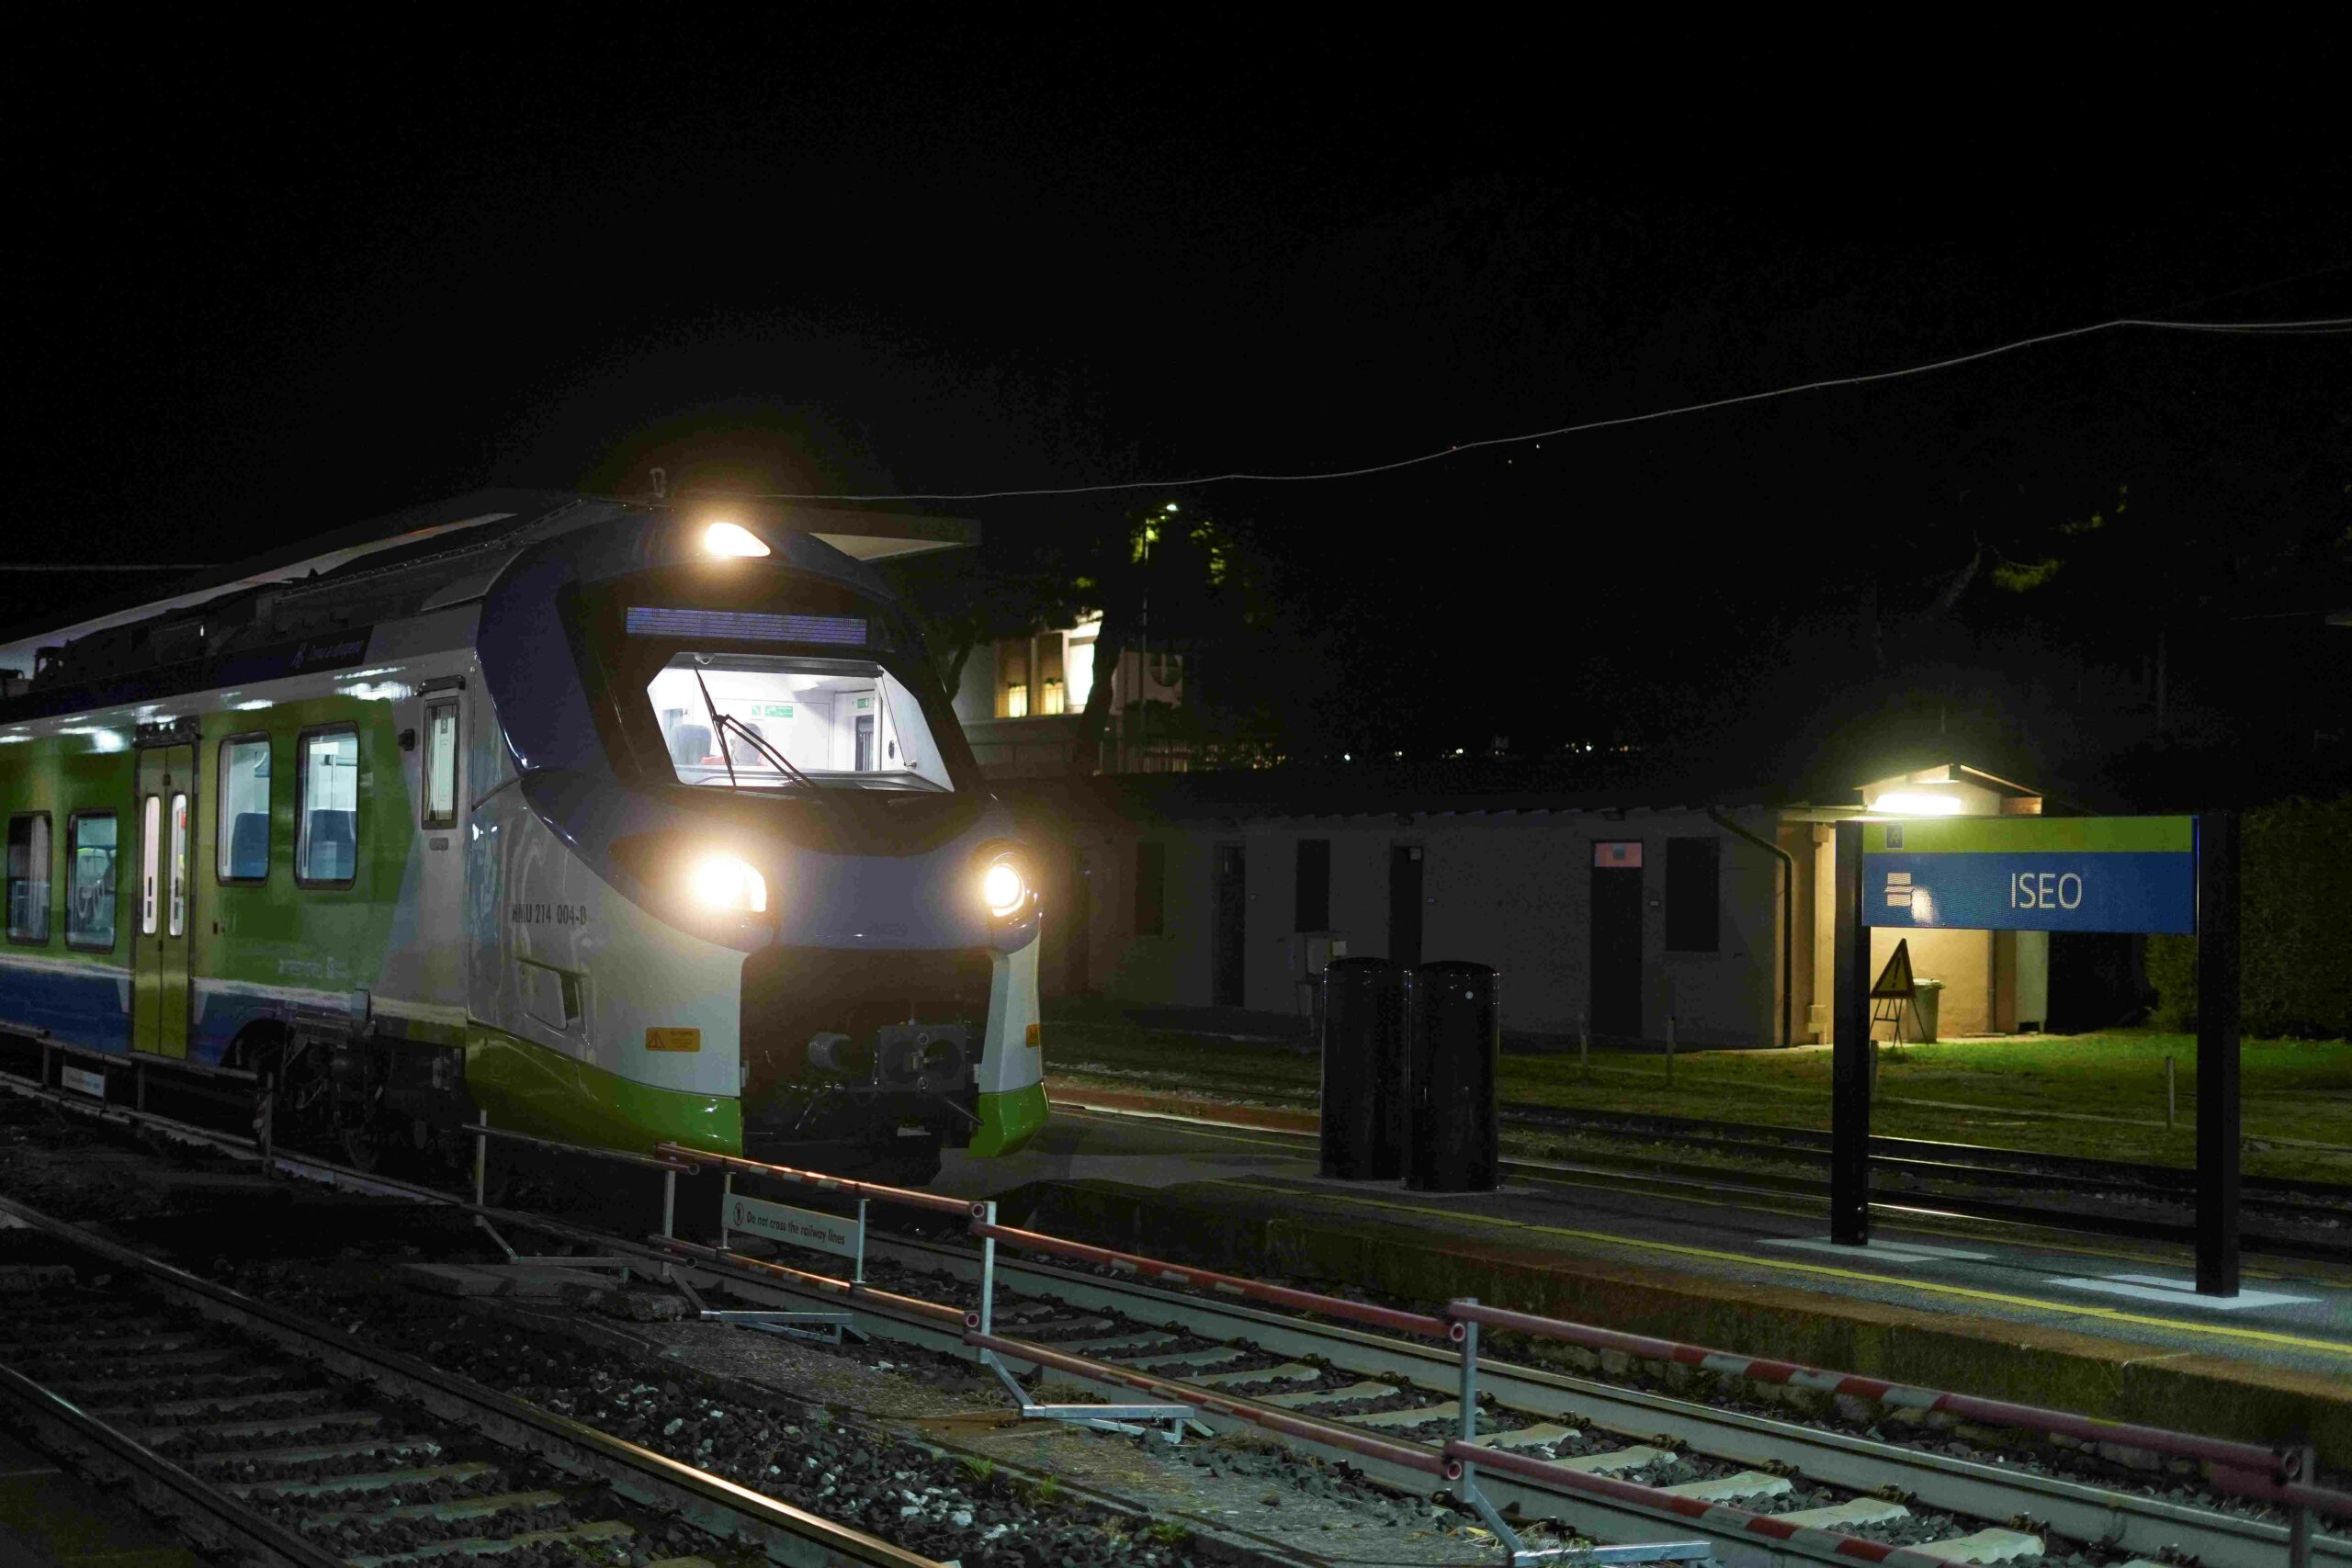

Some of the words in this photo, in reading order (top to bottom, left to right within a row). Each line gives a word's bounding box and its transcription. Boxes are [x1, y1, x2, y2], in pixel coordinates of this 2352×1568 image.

[2010, 873, 2083, 909] ISEO
[536, 903, 551, 924] 214
[747, 1210, 756, 1224] Do
[757, 1215, 769, 1227] not
[770, 1219, 786, 1232] cross
[788, 1219, 799, 1235] the
[800, 1224, 827, 1243] railway
[828, 1227, 846, 1245] lines
